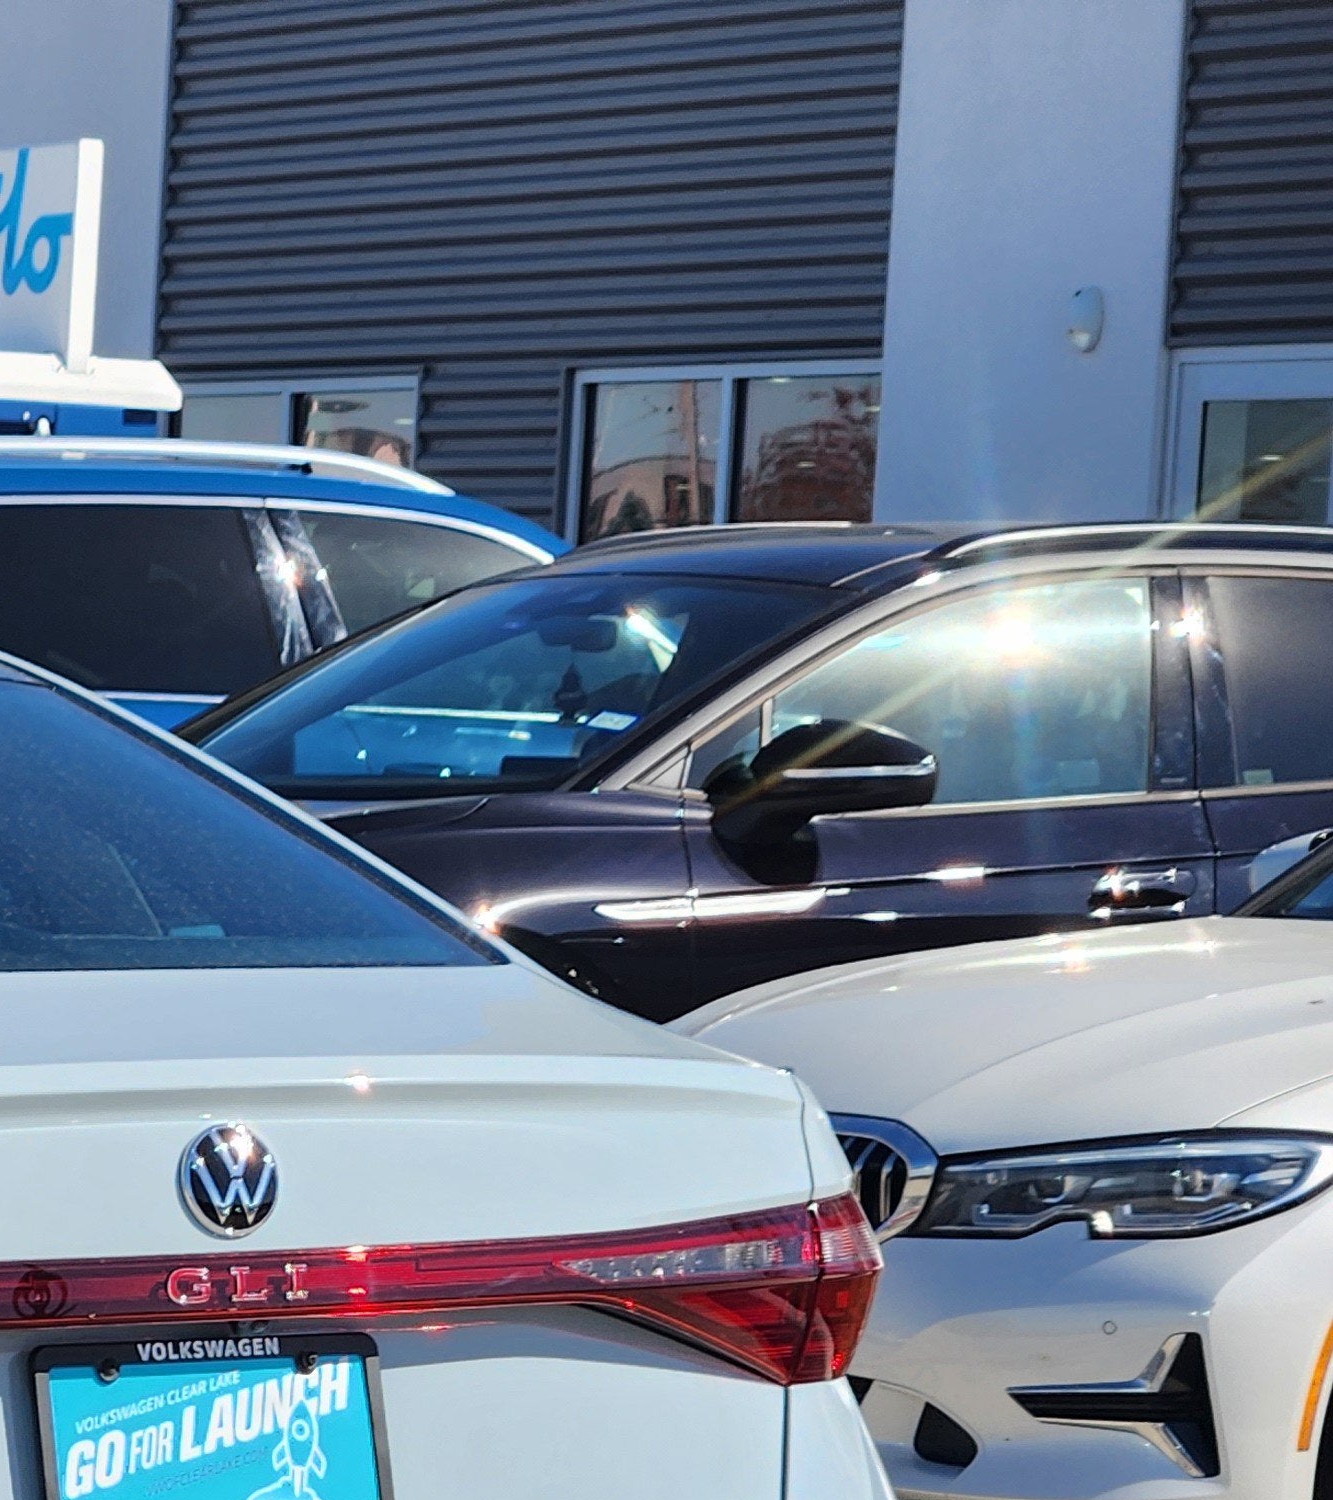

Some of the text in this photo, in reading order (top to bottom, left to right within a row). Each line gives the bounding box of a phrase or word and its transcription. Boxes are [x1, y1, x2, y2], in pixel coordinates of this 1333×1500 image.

[167, 1263, 310, 1305] GLI
[136, 1337, 280, 1362] VOLKSWAGEN
[64, 1358, 350, 1499] GO FOR LAUNCH
[75, 1371, 241, 1434] VOLKSWAGEN CLEAR LAKE
